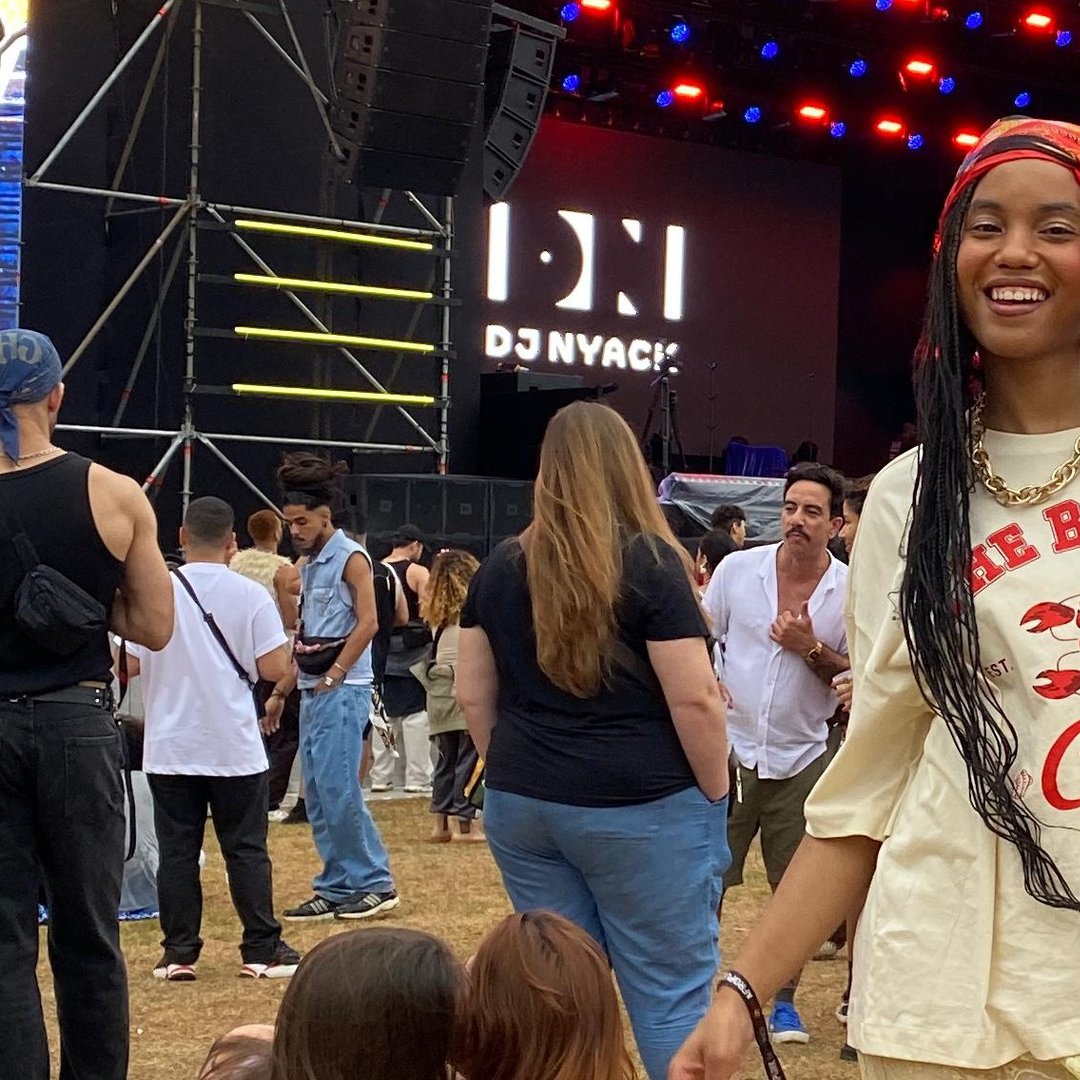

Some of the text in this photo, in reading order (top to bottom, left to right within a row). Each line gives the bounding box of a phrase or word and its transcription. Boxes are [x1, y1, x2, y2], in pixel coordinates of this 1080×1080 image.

[485, 324, 680, 374] DJ NYACK
[970, 522, 1041, 598] HE
